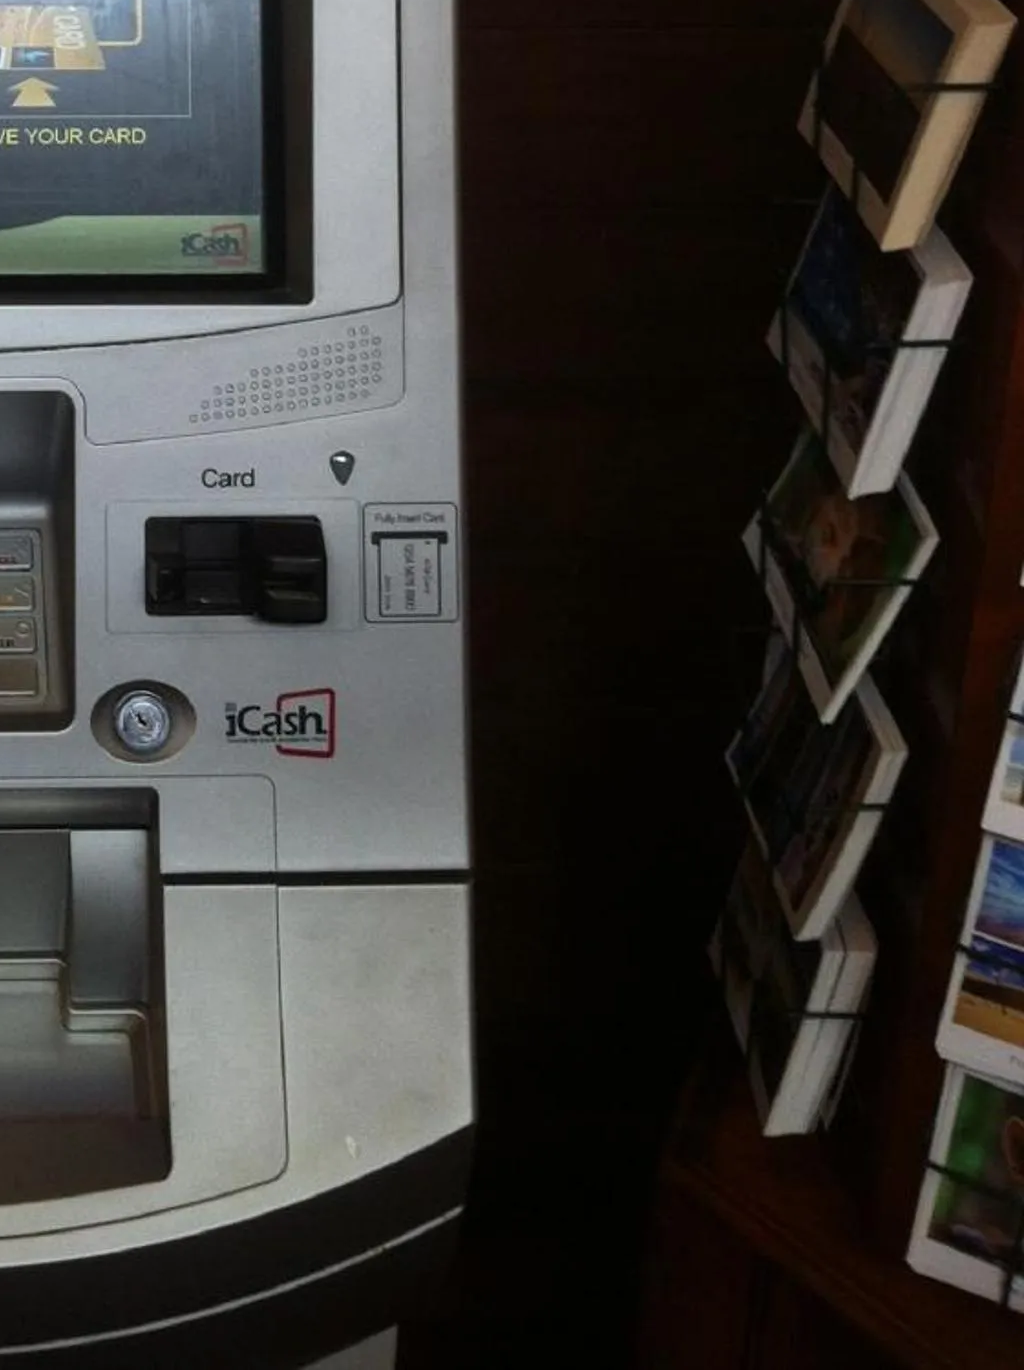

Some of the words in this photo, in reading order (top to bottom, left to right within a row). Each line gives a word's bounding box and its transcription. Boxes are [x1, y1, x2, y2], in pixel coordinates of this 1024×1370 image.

[24, 128, 83, 144] YOUR
[89, 127, 146, 144] CARD
[201, 467, 256, 488] Card
[225, 702, 327, 737] iCash
